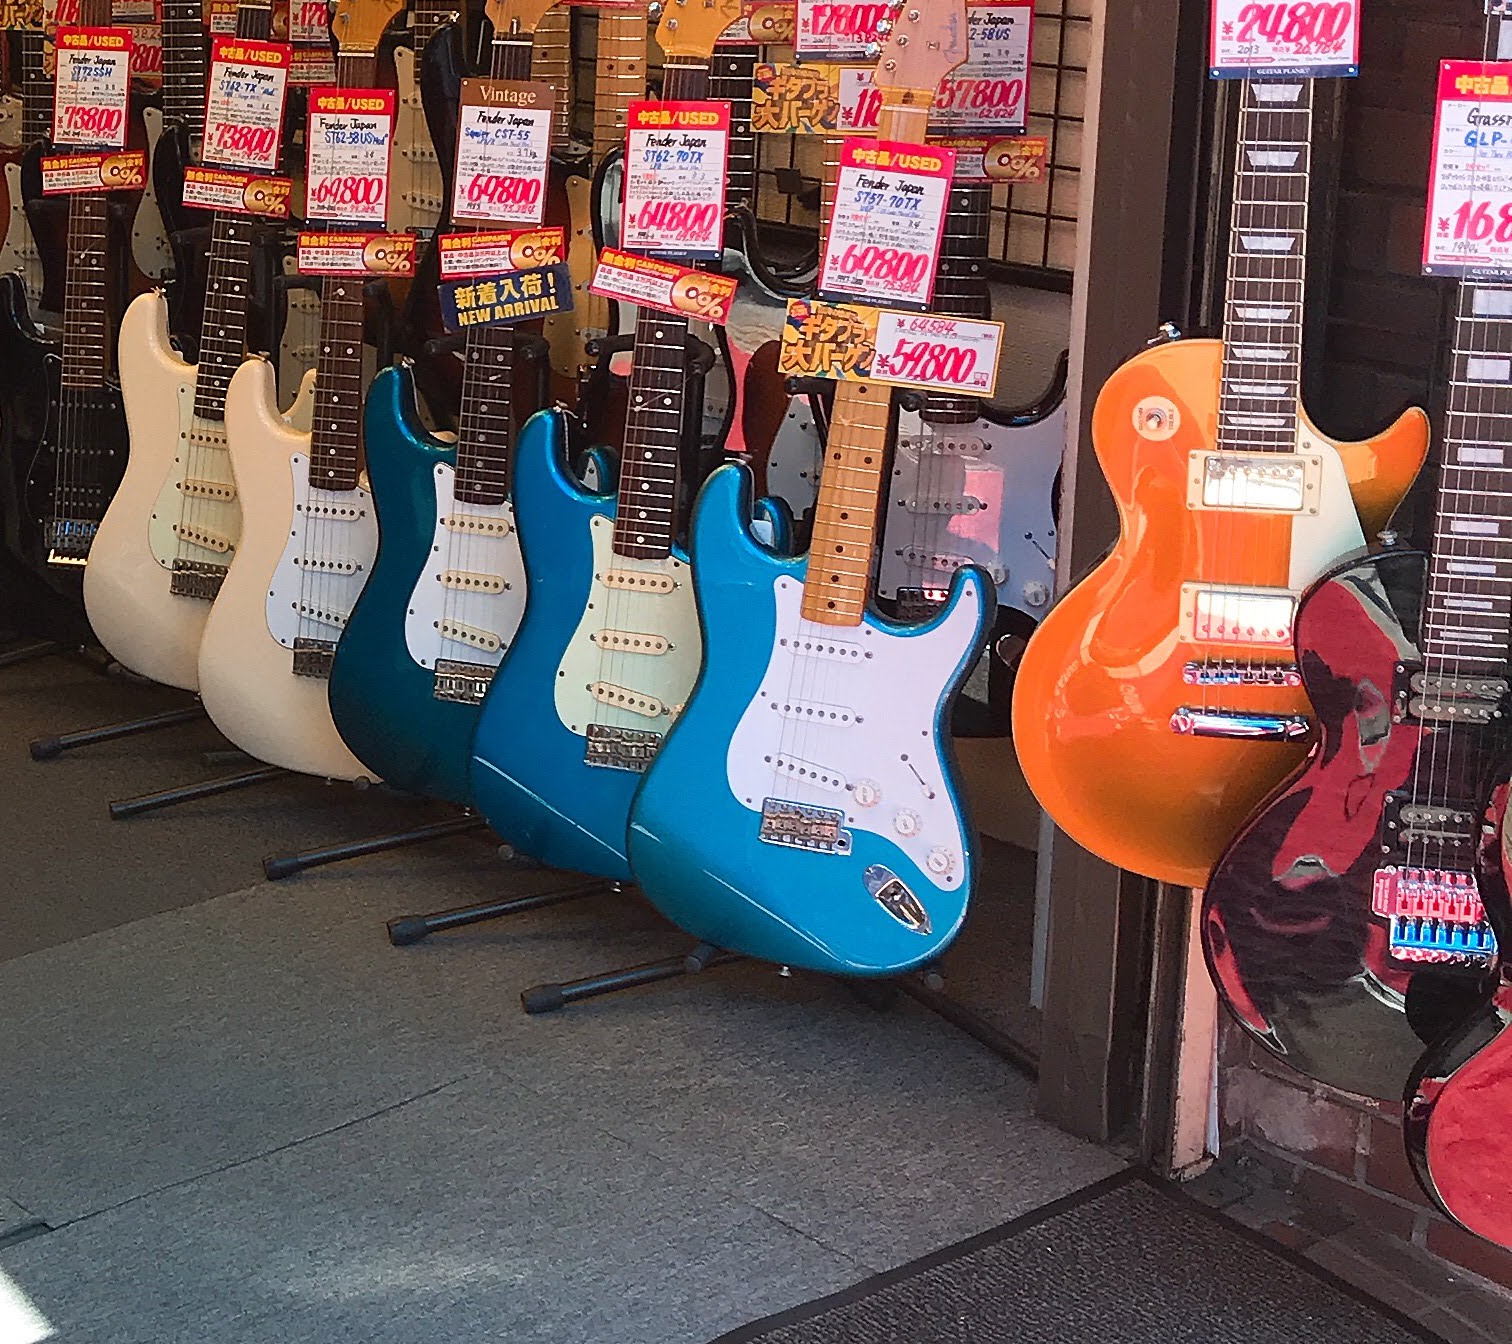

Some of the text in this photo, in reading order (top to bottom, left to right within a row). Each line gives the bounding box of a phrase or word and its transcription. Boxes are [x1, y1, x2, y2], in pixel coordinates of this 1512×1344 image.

[63, 34, 124, 47] 中古品/USED
[219, 47, 282, 63] 中古品/USED
[251, 69, 275, 84] Japan
[317, 97, 385, 111] 中古品/USED
[480, 85, 537, 106] Vintage
[319, 118, 377, 131] Fender Japan
[476, 110, 534, 127] Fender Japan
[638, 111, 719, 125] 中古品/USED
[646, 133, 707, 150] Fender Japan
[643, 149, 703, 163] ST62-70TX
[851, 149, 942, 172] 中古品/USED
[855, 173, 925, 195] Fender Japan
[854, 191, 922, 210] ST57-70TX
[454, 272, 558, 310] 新着入荷!
[457, 294, 559, 327] NEW ARRIVAL
